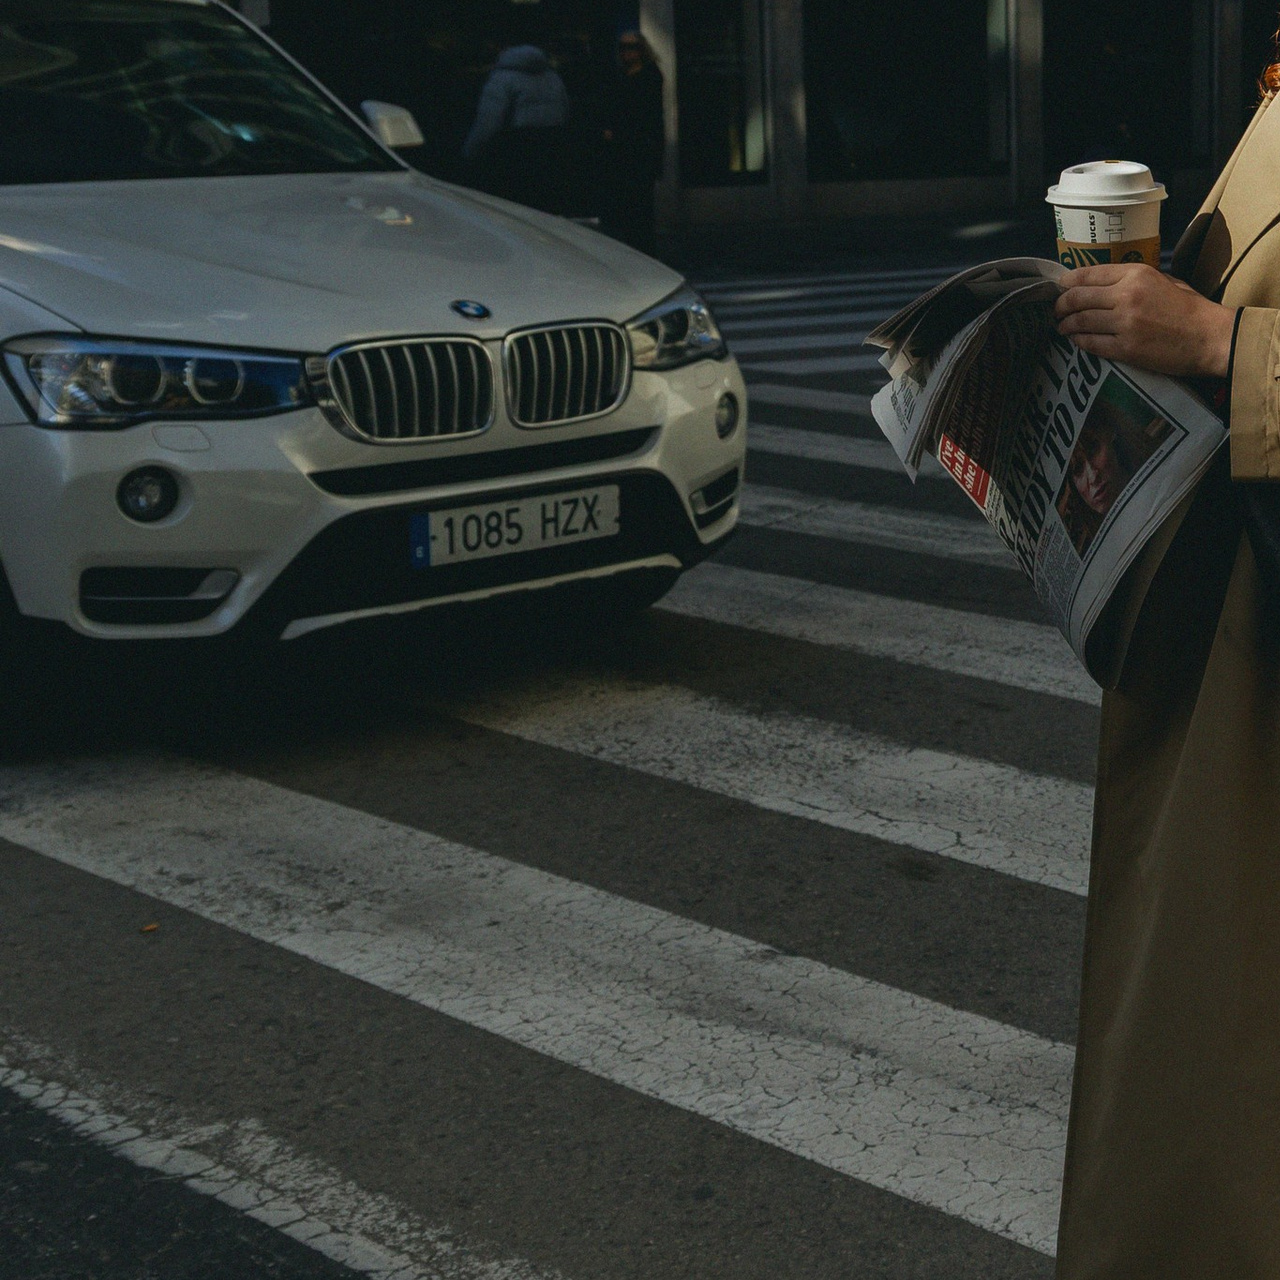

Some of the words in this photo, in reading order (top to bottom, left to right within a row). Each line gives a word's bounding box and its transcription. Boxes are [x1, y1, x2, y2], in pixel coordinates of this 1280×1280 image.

[941, 440, 954, 468] I've
[1016, 454, 1055, 586] EADY
[1043, 402, 1075, 473] TO
[1066, 347, 1102, 414] GO
[952, 461, 964, 480] in
[964, 465, 977, 493] she
[444, 507, 523, 554] 1085
[541, 494, 599, 540] HZX
